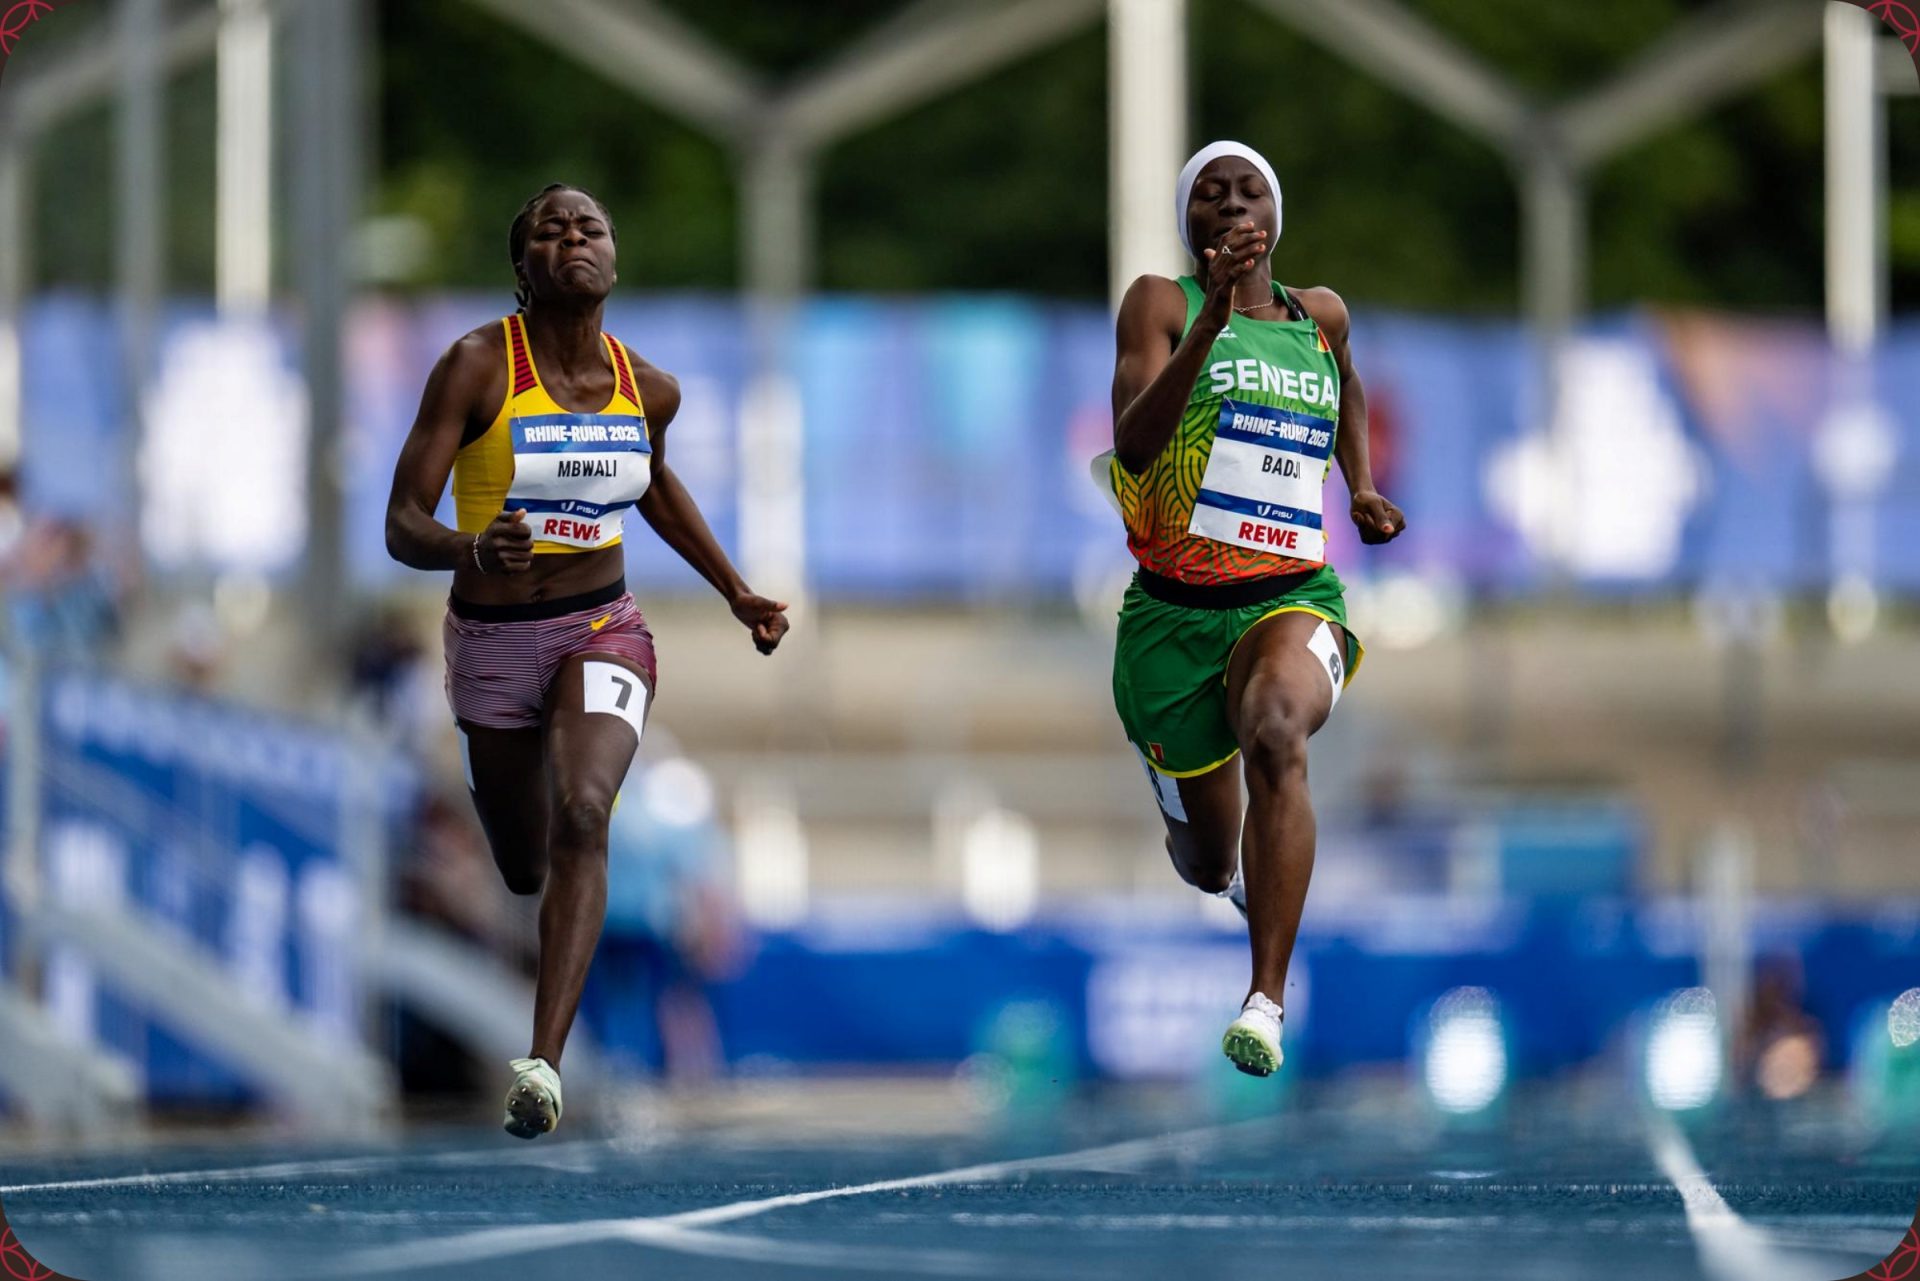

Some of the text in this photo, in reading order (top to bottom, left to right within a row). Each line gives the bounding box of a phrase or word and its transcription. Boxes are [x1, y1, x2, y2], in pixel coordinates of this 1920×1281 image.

[524, 425, 640, 443] RHINE-RUHR 2025
[1232, 412, 1330, 449] RHINE-RUHR 2025
[557, 459, 617, 478] MBWALI
[575, 505, 599, 516] FISU
[1271, 509, 1293, 520] FISU
[543, 518, 601, 542] REWE
[1238, 521, 1299, 549] REWE
[610, 675, 632, 711] 7
